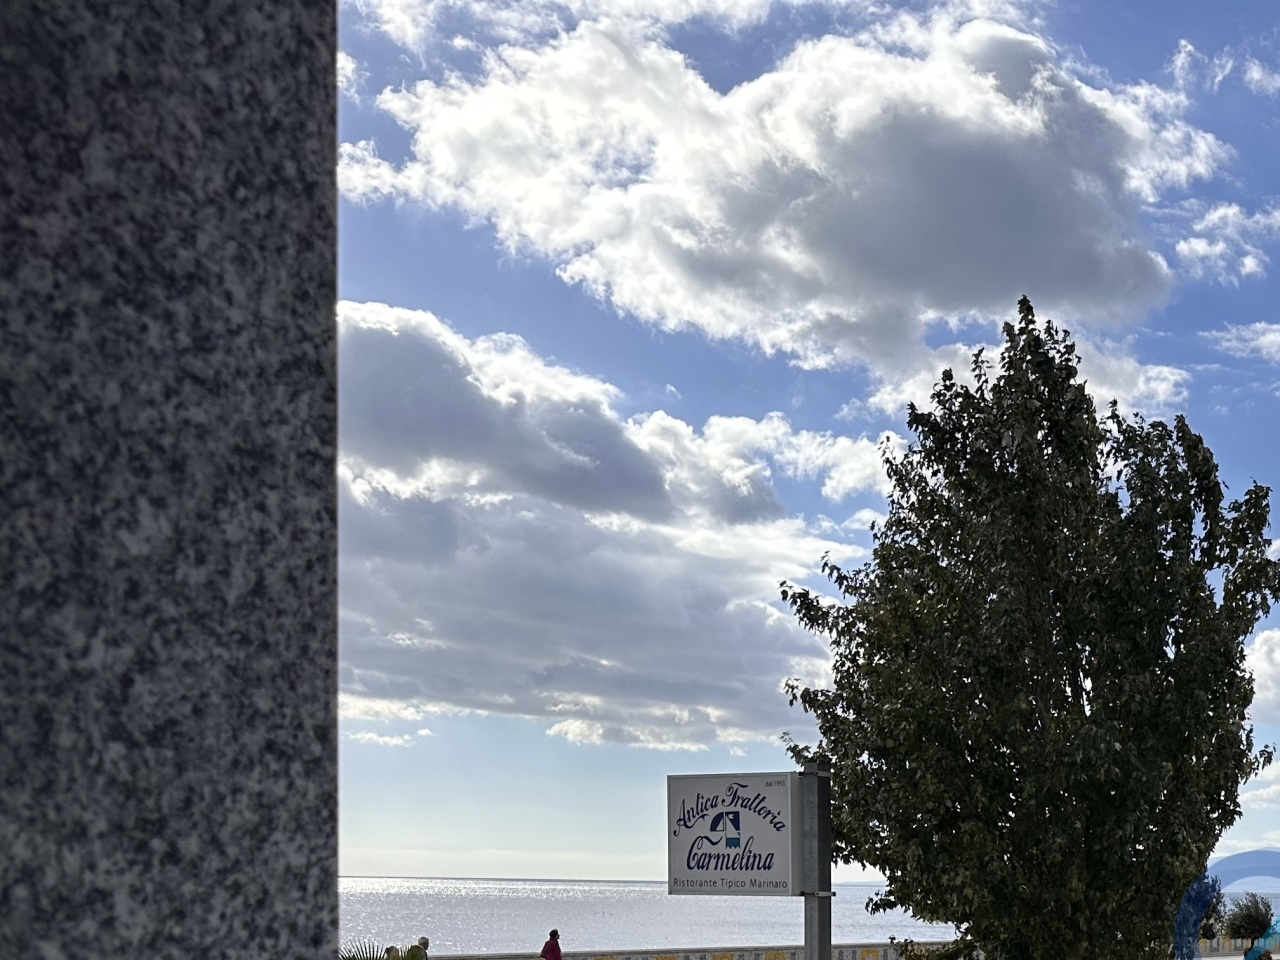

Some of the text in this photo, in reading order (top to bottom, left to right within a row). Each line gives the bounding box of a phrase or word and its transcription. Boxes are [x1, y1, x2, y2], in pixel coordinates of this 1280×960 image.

[673, 782, 786, 837] Antica Trattoria
[686, 835, 775, 871] Carmelina
[673, 878, 788, 890] Ristorante Tipico Marinaro
